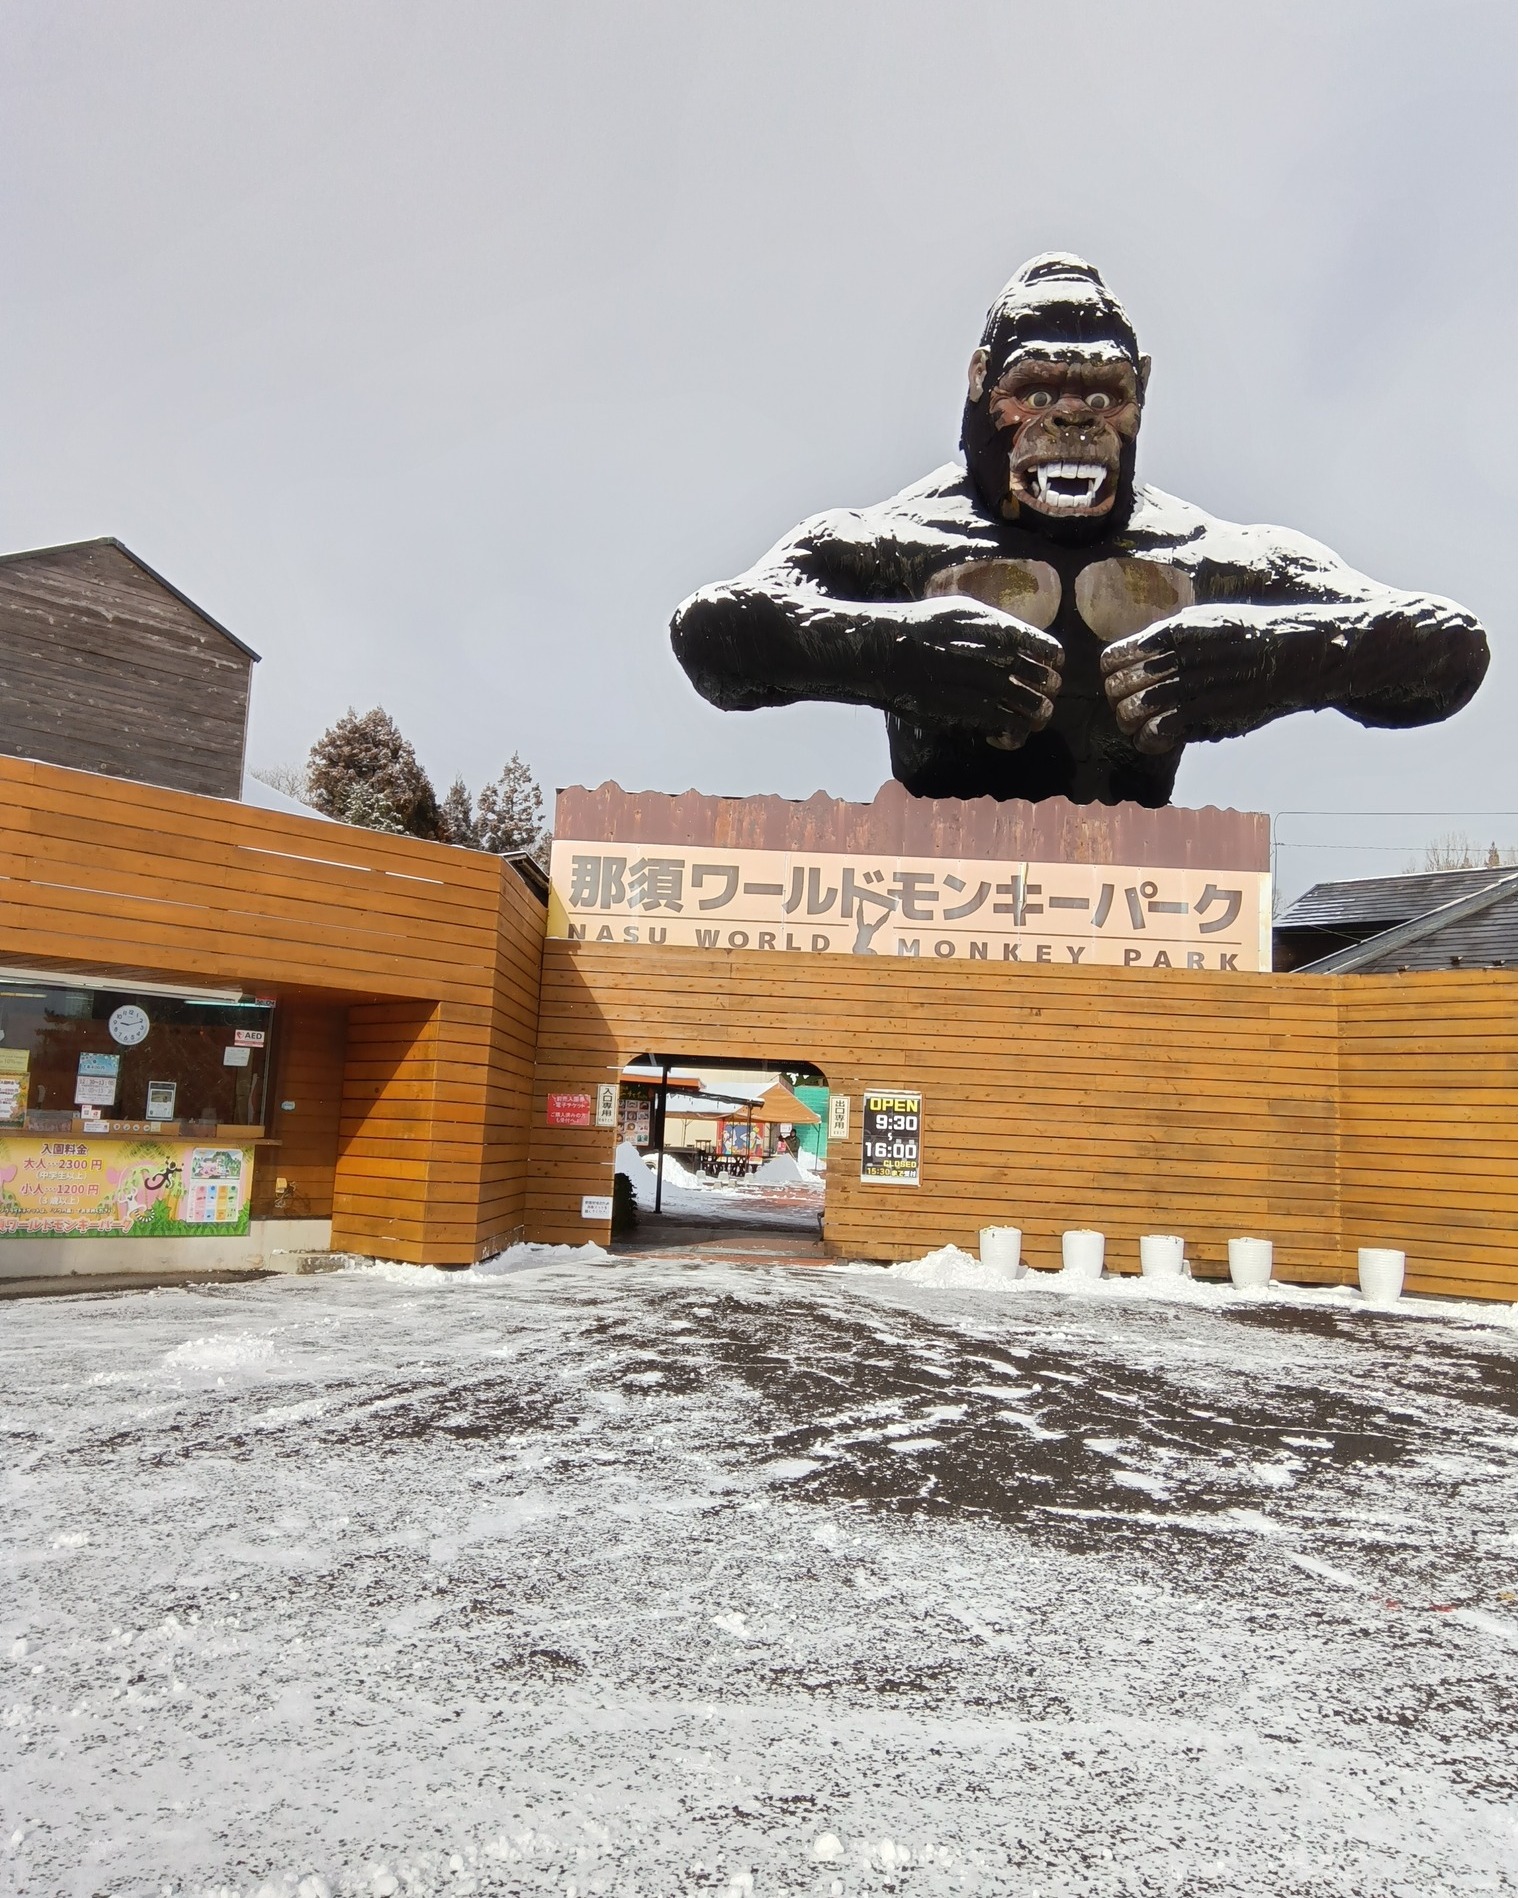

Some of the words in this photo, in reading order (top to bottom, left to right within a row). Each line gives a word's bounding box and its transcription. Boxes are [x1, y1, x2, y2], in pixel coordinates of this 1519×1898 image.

[569, 854, 1243, 934] 那須ワールドモンキーパーク
[567, 923, 668, 945] NASU
[695, 928, 831, 952] WORLD
[898, 937, 1086, 964] MONKEY
[1124, 947, 1238, 971] PARK
[244, 1032, 263, 1040] AED
[602, 1088, 613, 1117] 入口専用
[870, 1097, 918, 1112] OPEN
[834, 1100, 845, 1129] 出口専用
[875, 1114, 918, 1131] 9:30
[41, 1143, 88, 1155] 入園料金
[865, 1142, 917, 1159] 16:00
[883, 1160, 917, 1168] CLOSED
